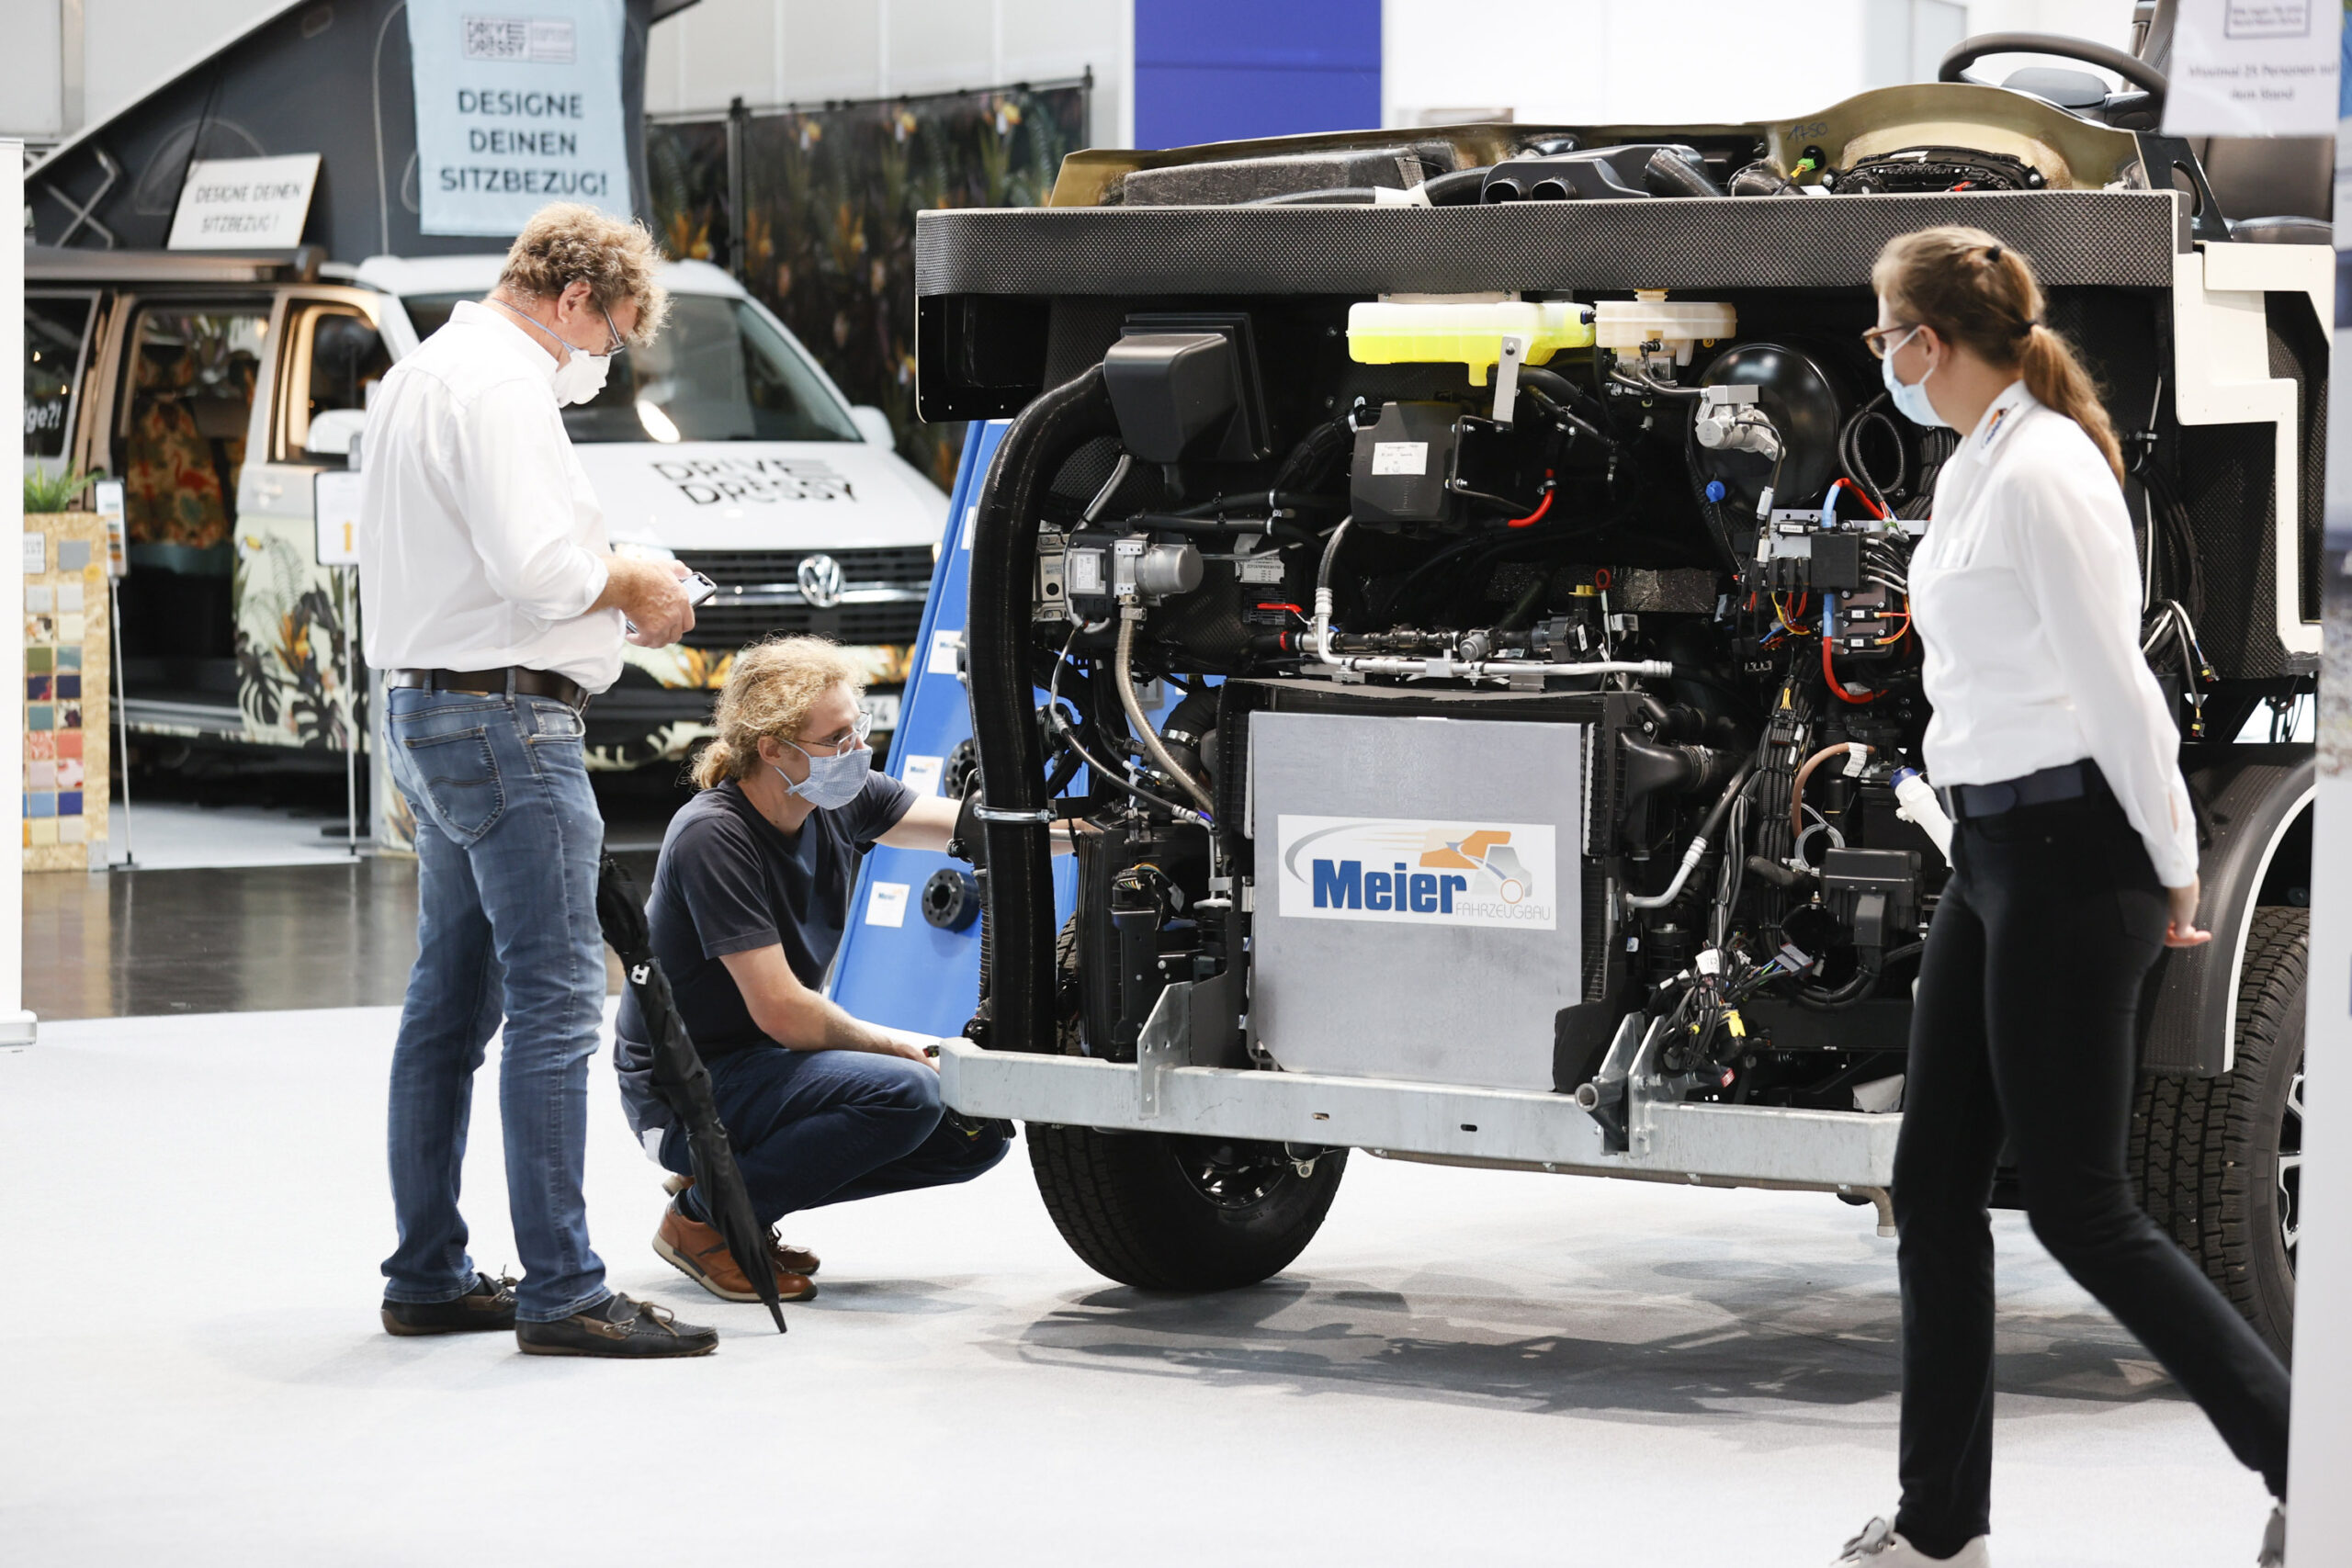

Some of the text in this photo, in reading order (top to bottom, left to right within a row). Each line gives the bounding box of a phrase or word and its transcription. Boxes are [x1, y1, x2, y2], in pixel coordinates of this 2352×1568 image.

[458, 90, 583, 119] DESIGNE
[469, 129, 577, 156] DEINEN
[195, 181, 302, 203] DESIGNE DEINEN
[440, 167, 608, 197] SITZBEZUG!
[24, 399, 62, 434] ge?!
[1313, 858, 1467, 914] Meier
[1455, 901, 1551, 920] FAHRZEUGBAU
